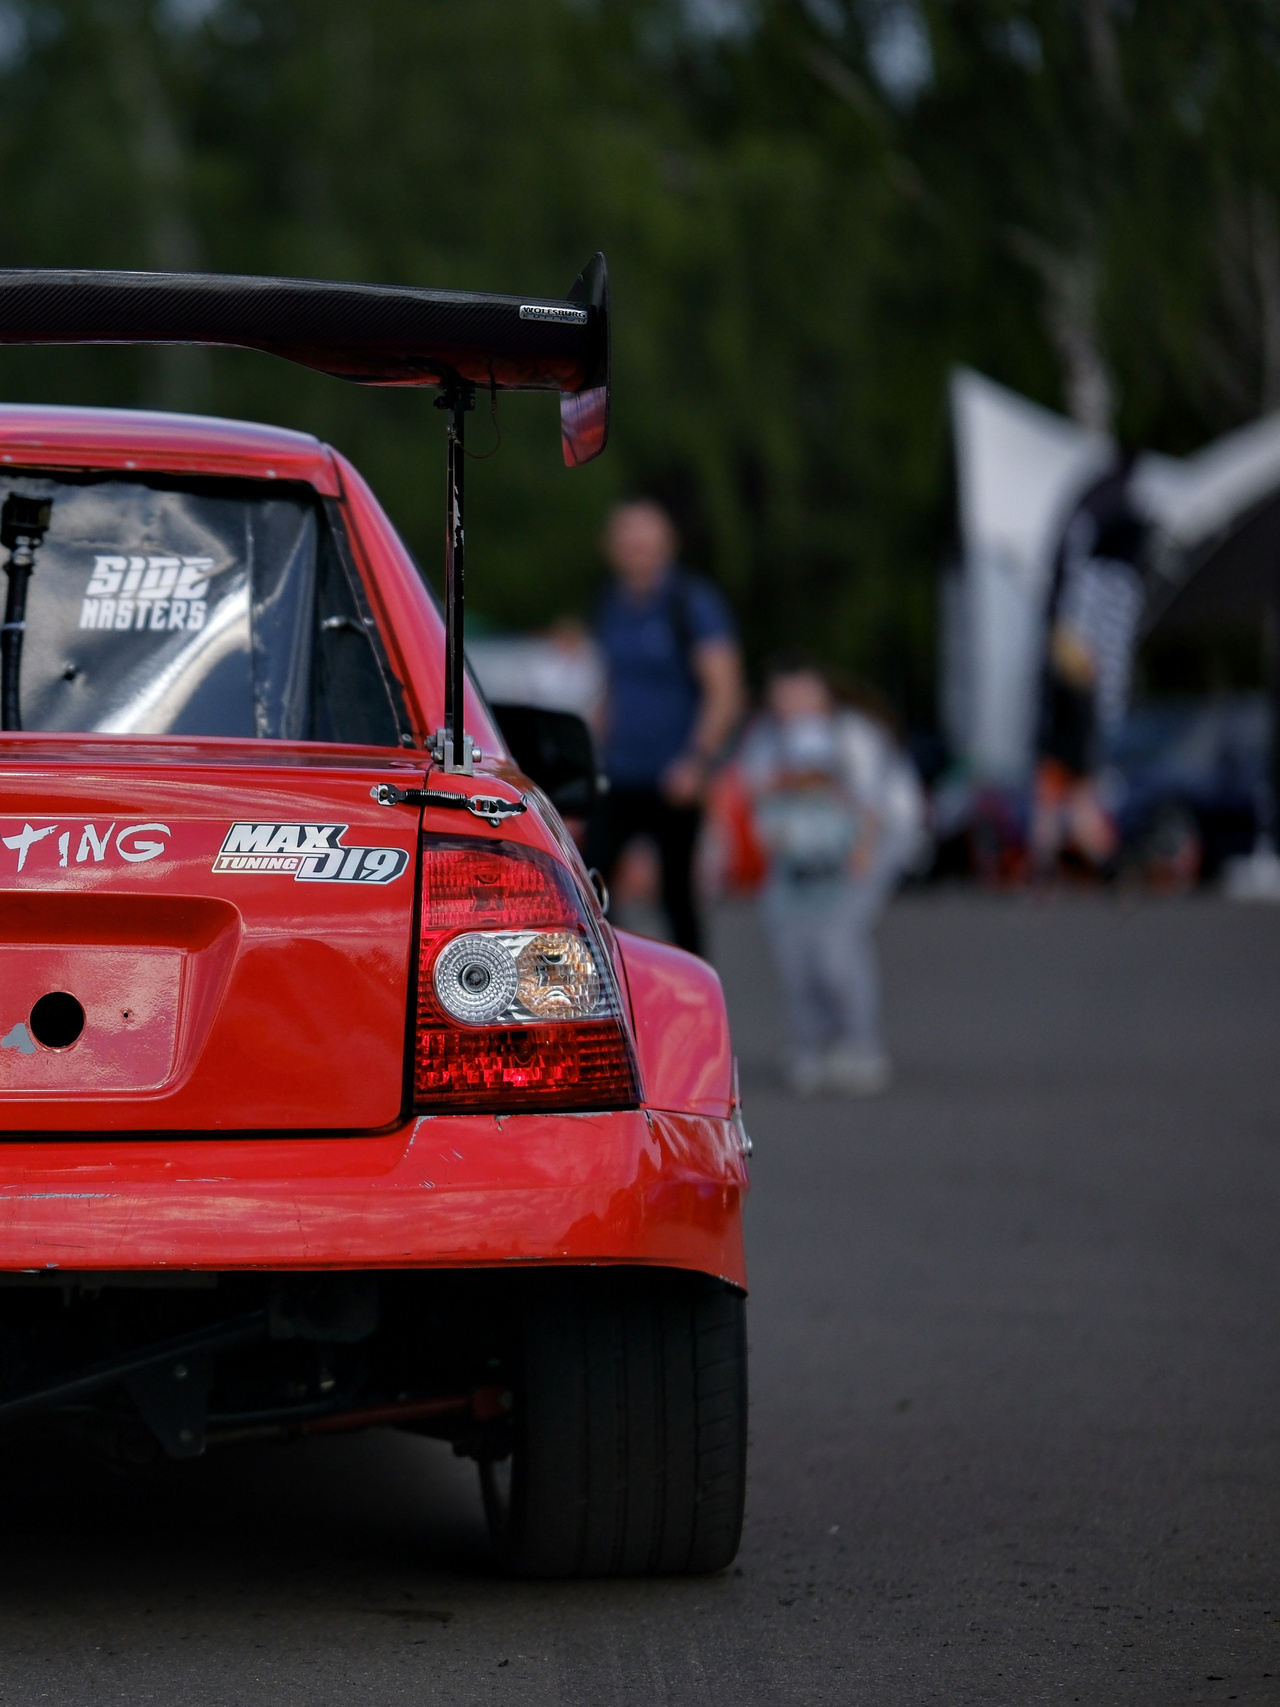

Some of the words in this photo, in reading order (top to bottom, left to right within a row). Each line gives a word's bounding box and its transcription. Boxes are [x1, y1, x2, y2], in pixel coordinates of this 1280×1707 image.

[86, 556, 214, 598] SIDE
[79, 599, 208, 629] MASTERS
[222, 825, 336, 852] MAX
[220, 857, 299, 869] TUNING
